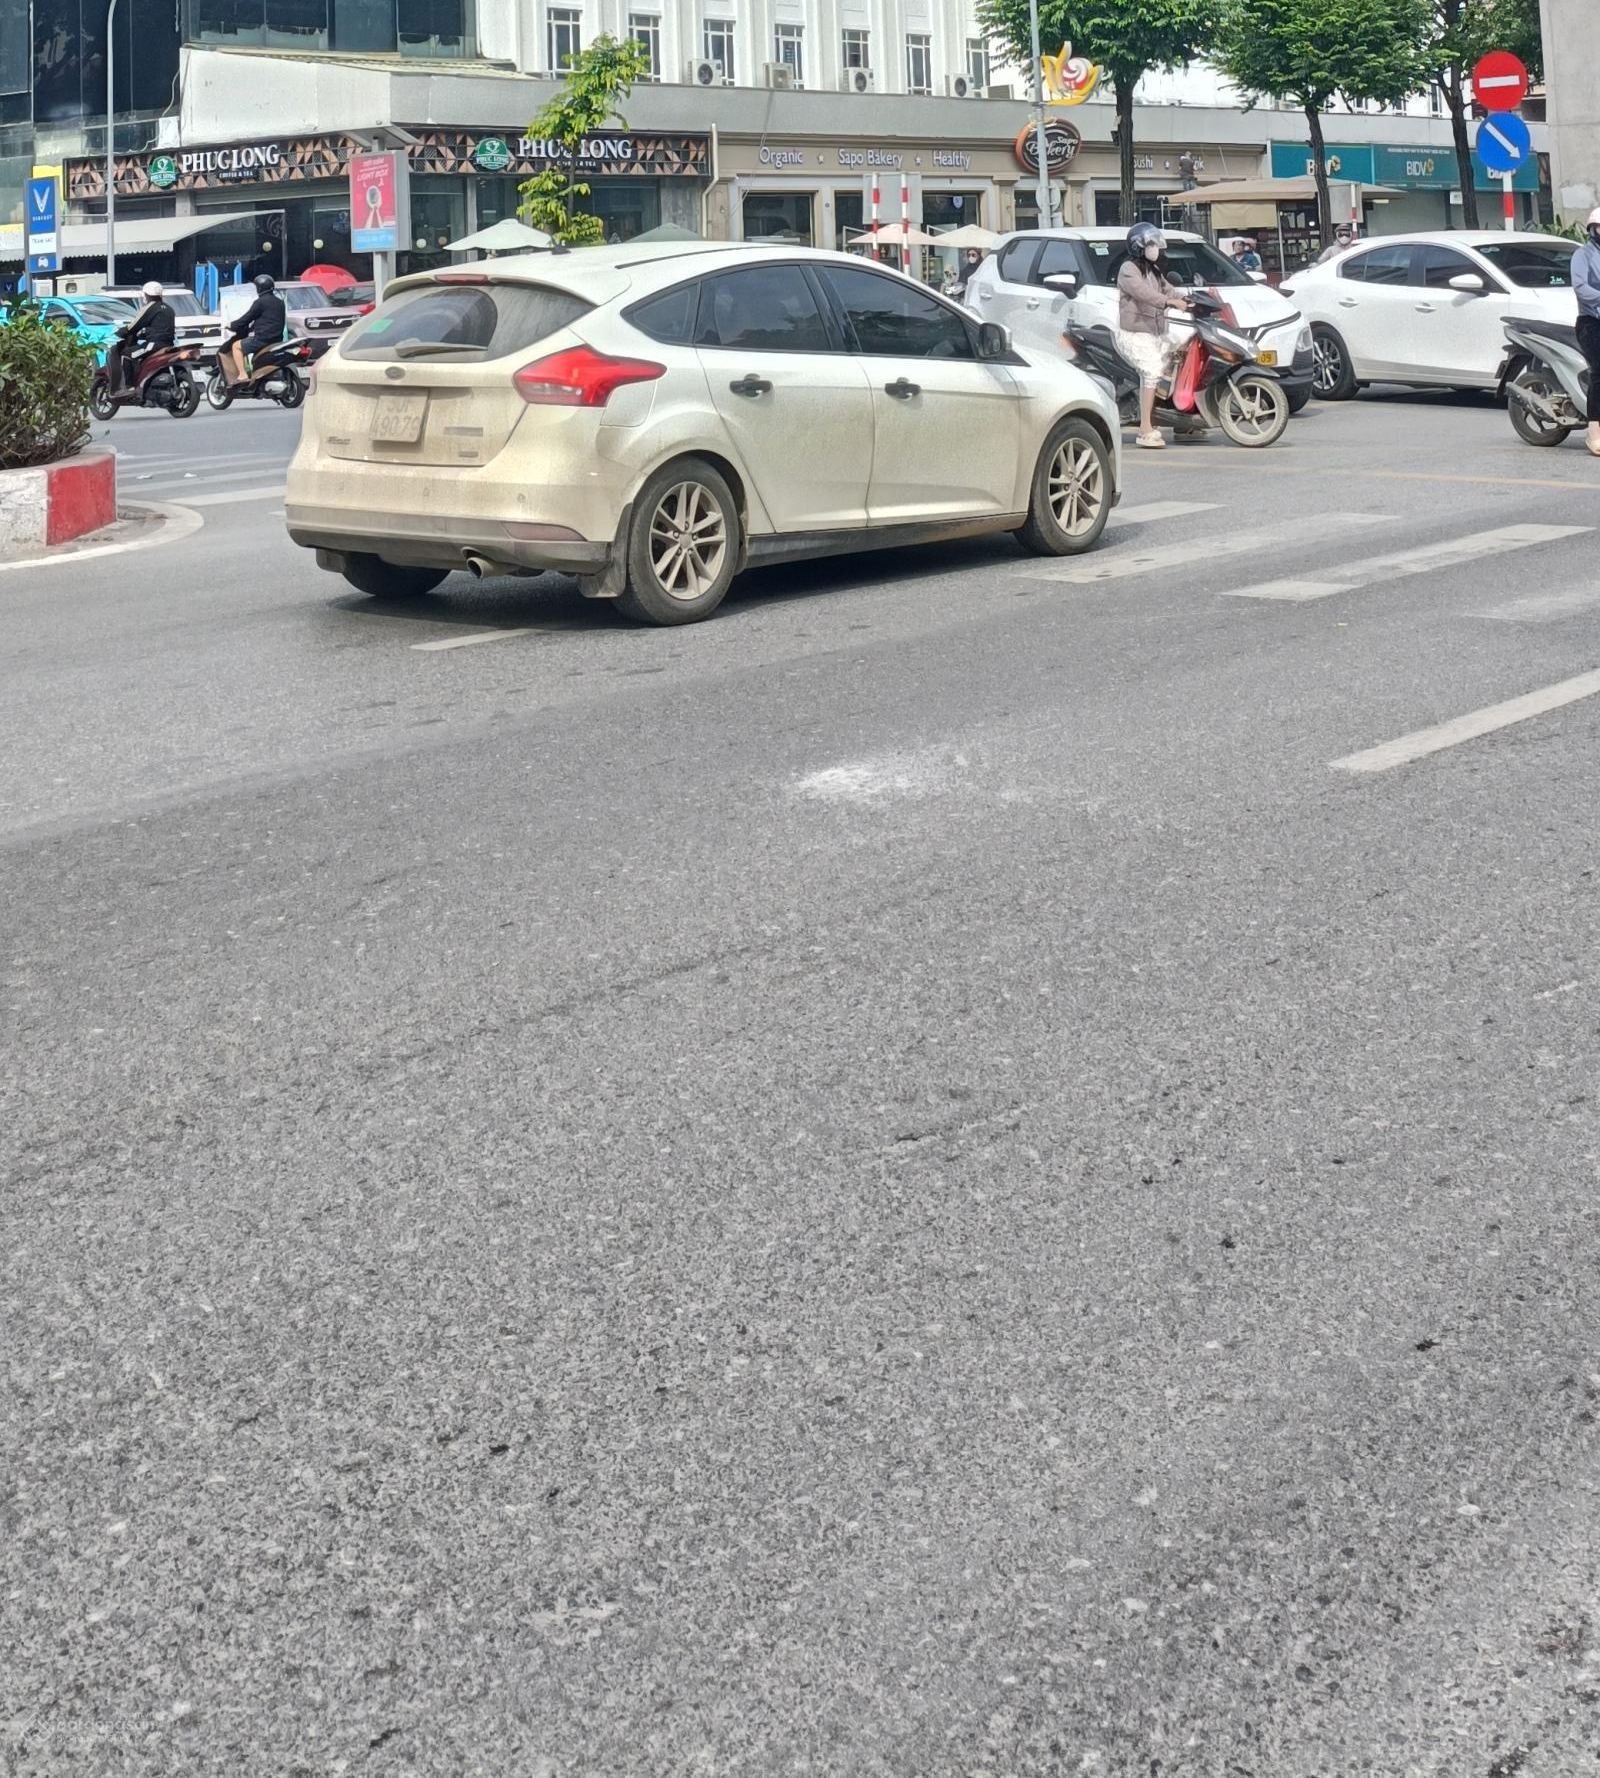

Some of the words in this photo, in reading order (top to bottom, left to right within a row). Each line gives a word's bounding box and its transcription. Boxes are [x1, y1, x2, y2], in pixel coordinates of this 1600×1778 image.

[517, 138, 573, 158] PHU
[577, 139, 632, 159] LONG
[1026, 141, 1076, 159] Bkery
[1056, 136, 1079, 145] Sapo
[231, 144, 280, 170] LONG
[759, 146, 804, 168] Organic
[839, 148, 864, 169] Sapo
[867, 149, 903, 170] Bakery
[933, 150, 971, 171] Healthy
[1406, 160, 1427, 176] BIDV
